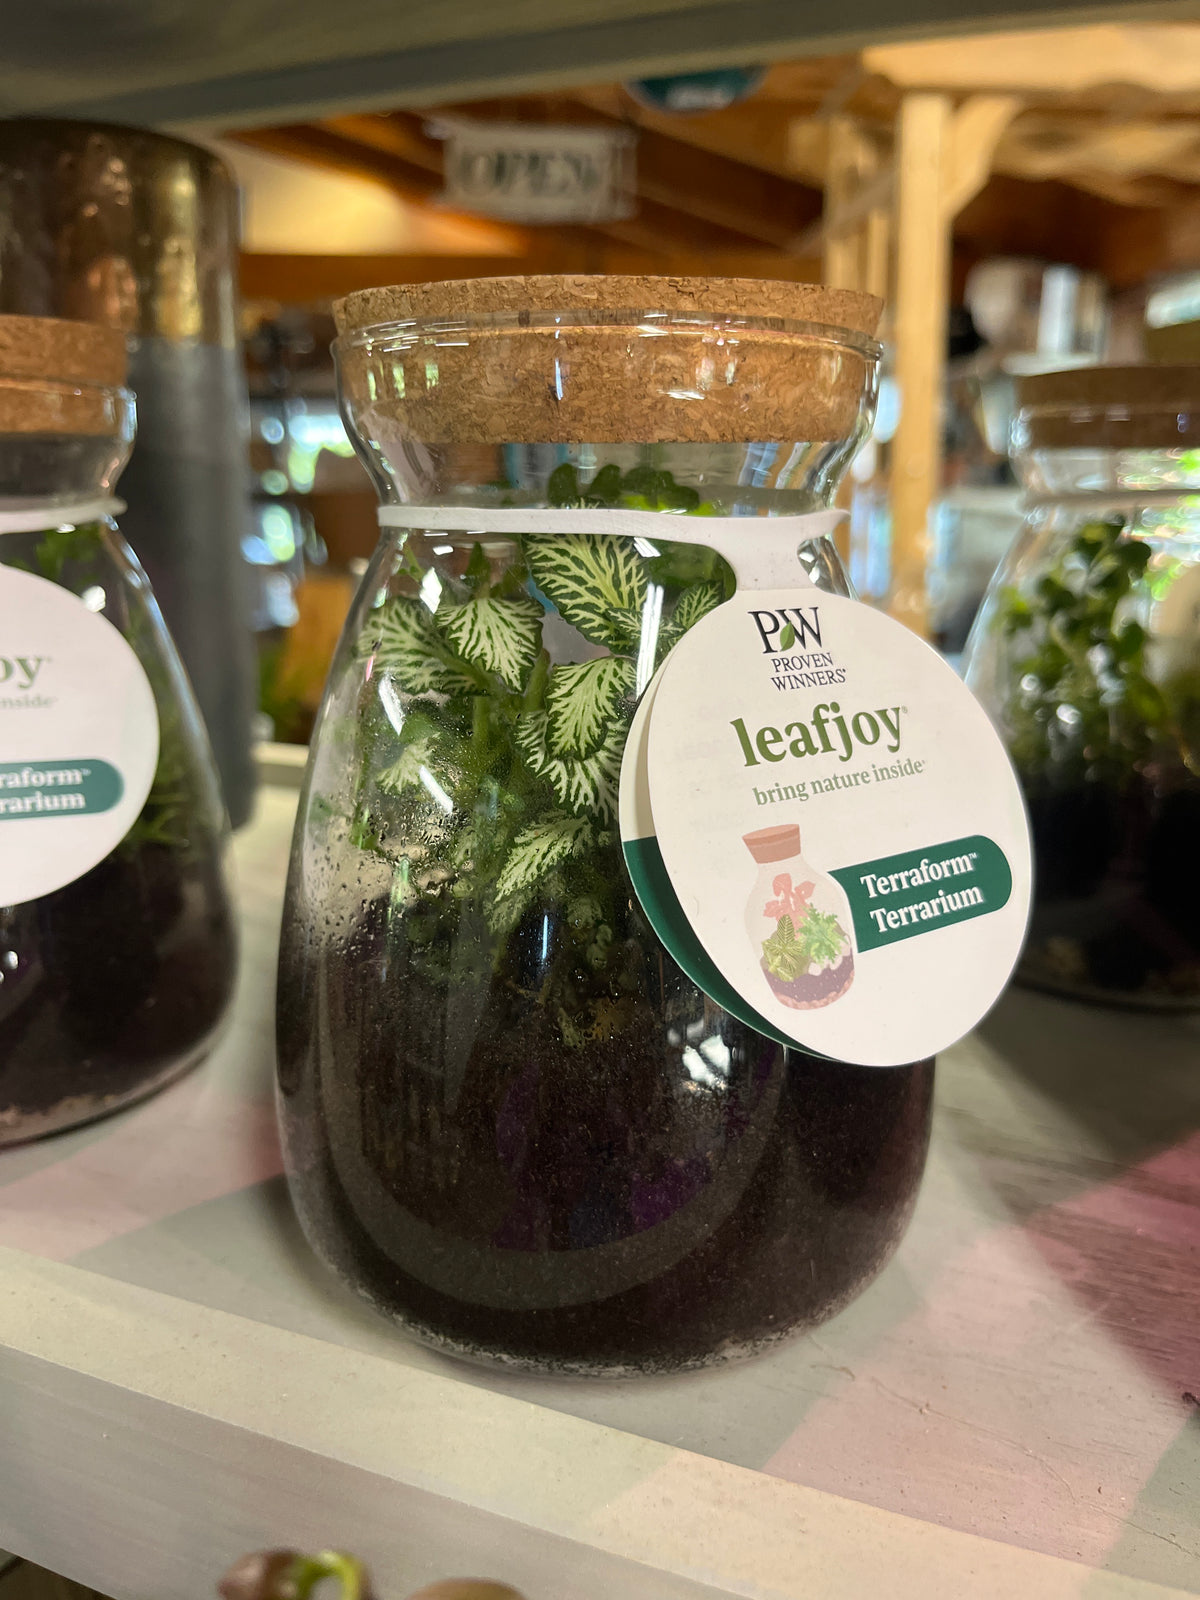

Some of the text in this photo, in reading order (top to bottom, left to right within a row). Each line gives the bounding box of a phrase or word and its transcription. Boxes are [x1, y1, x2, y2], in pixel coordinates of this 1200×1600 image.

[770, 652, 834, 673] PROVEN
[752, 782, 809, 806] bring
[810, 769, 871, 794] nature
[869, 886, 984, 933] Terrarium
